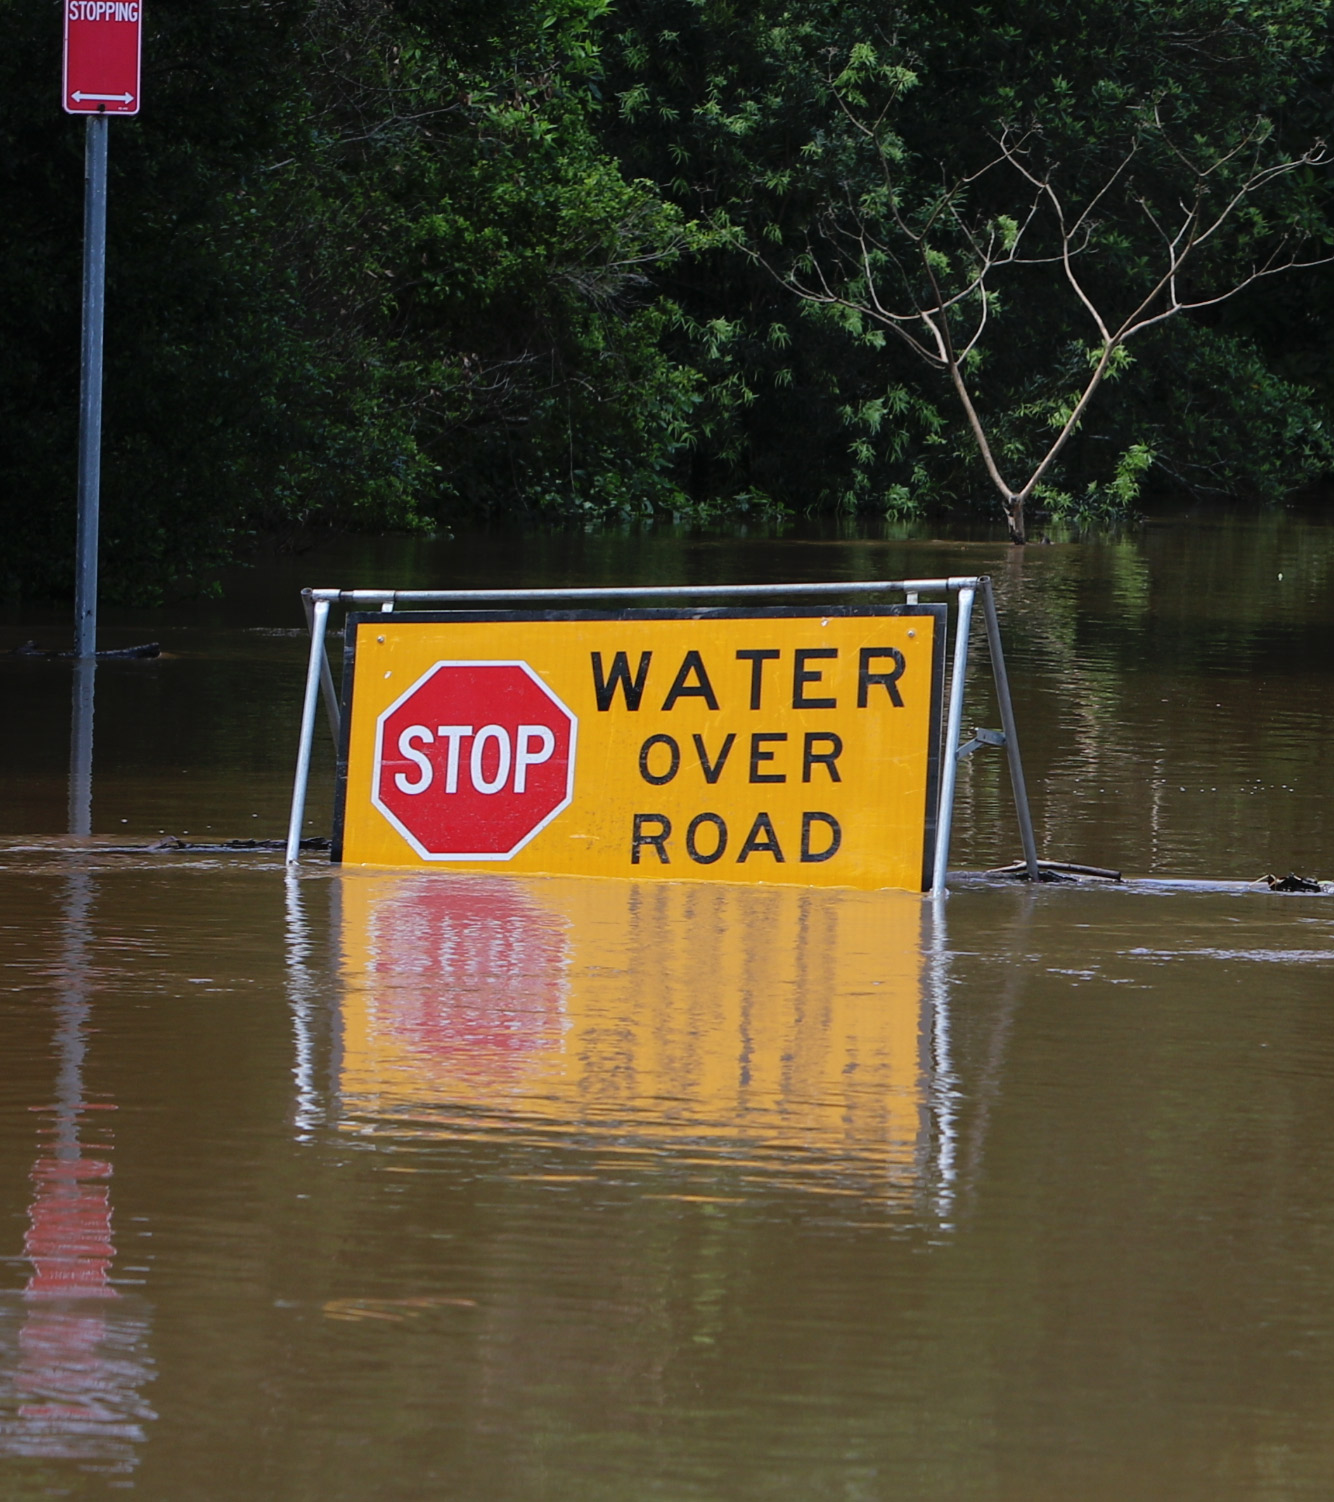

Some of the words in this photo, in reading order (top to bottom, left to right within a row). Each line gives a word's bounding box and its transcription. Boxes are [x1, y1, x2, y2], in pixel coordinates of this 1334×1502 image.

[69, 1, 138, 21] STOPPING
[591, 647, 906, 711] WATER
[394, 724, 555, 796] STOP
[639, 731, 843, 786] OVER
[631, 811, 842, 866] ROAD
